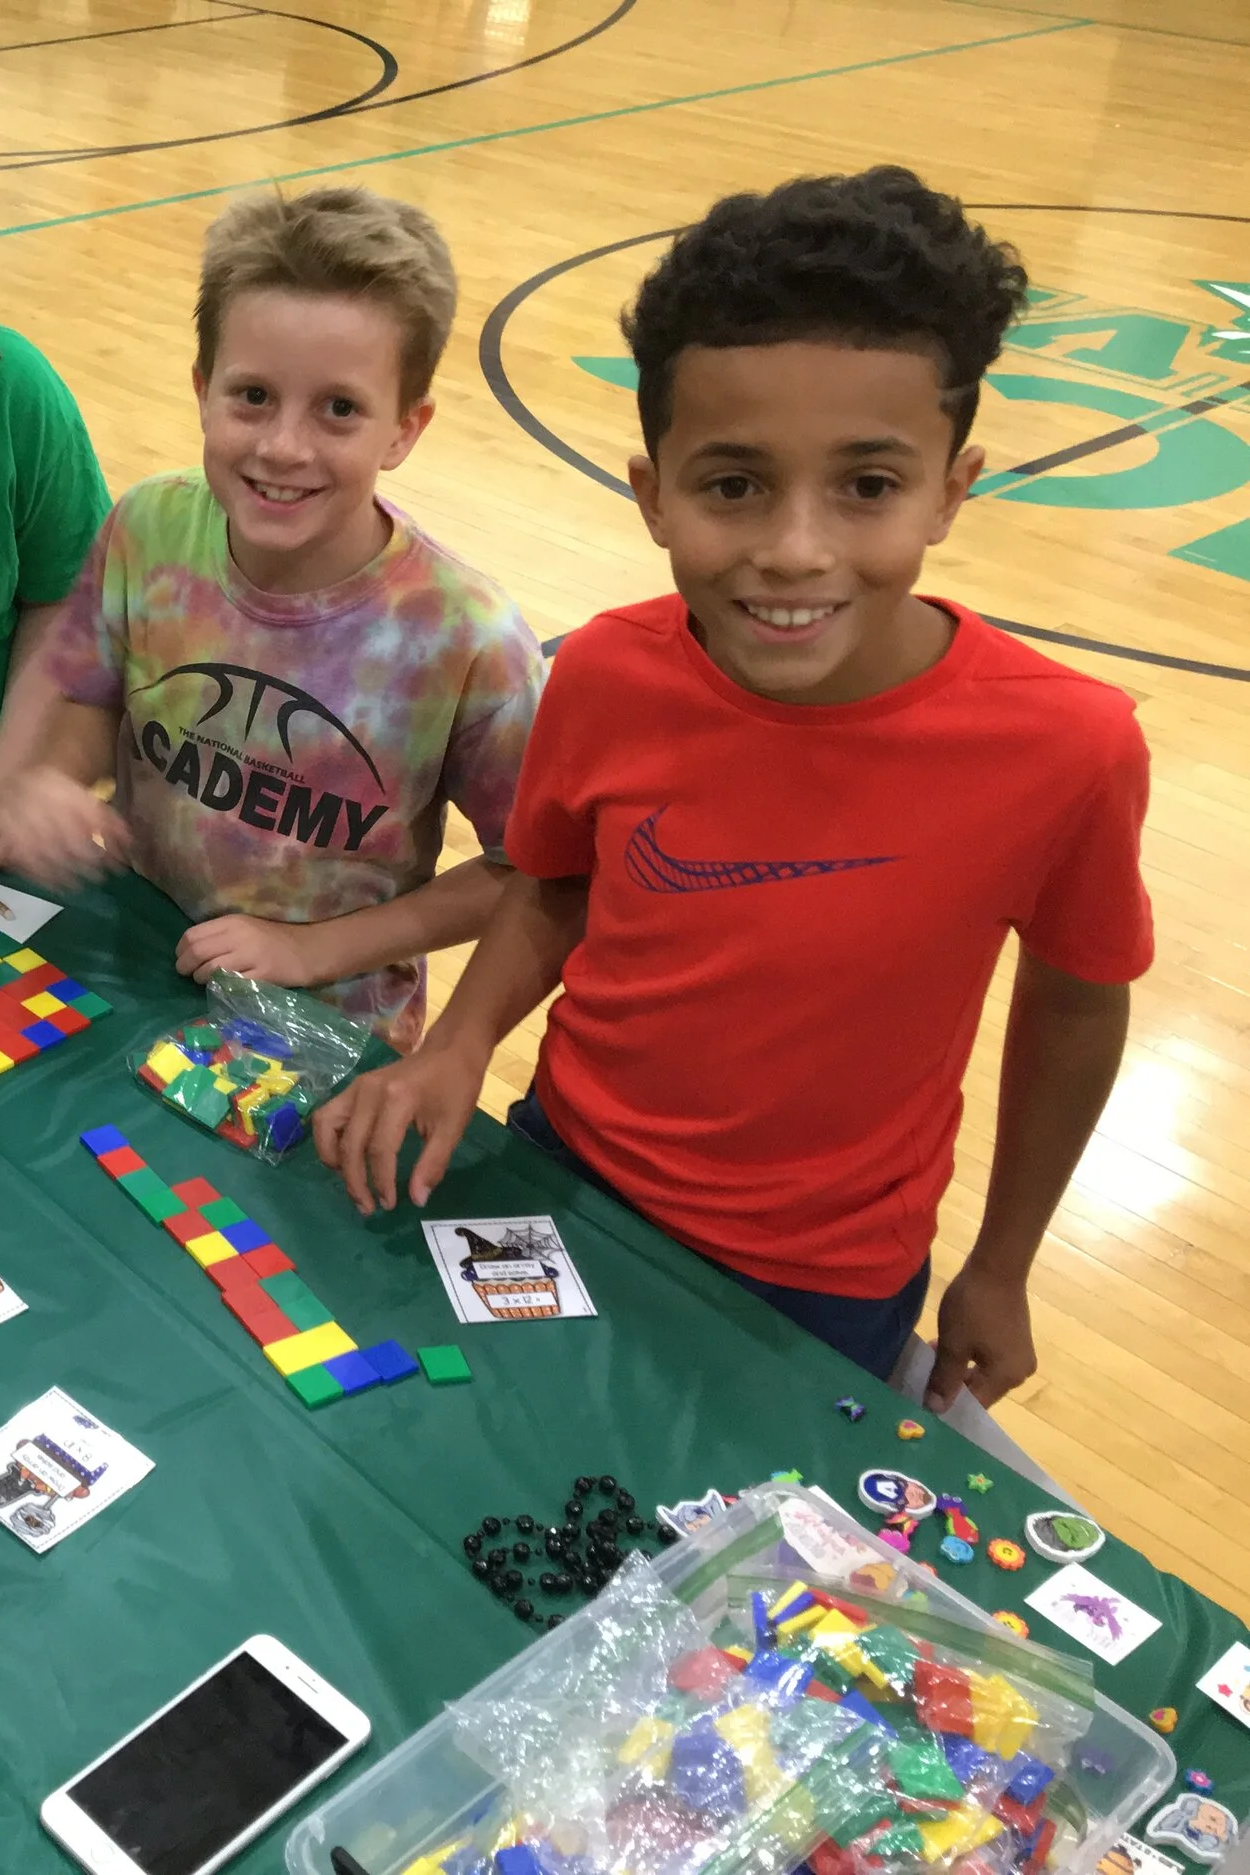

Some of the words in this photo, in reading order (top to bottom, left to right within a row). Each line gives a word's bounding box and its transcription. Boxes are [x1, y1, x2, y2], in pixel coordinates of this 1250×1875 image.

[179, 726, 196, 740] THE
[196, 736, 244, 760] NATIONAL
[243, 755, 306, 784] BASKETBALL
[502, 1297, 510, 1305] 3
[523, 1296, 532, 1304] 12
[876, 1481, 899, 1499] A
